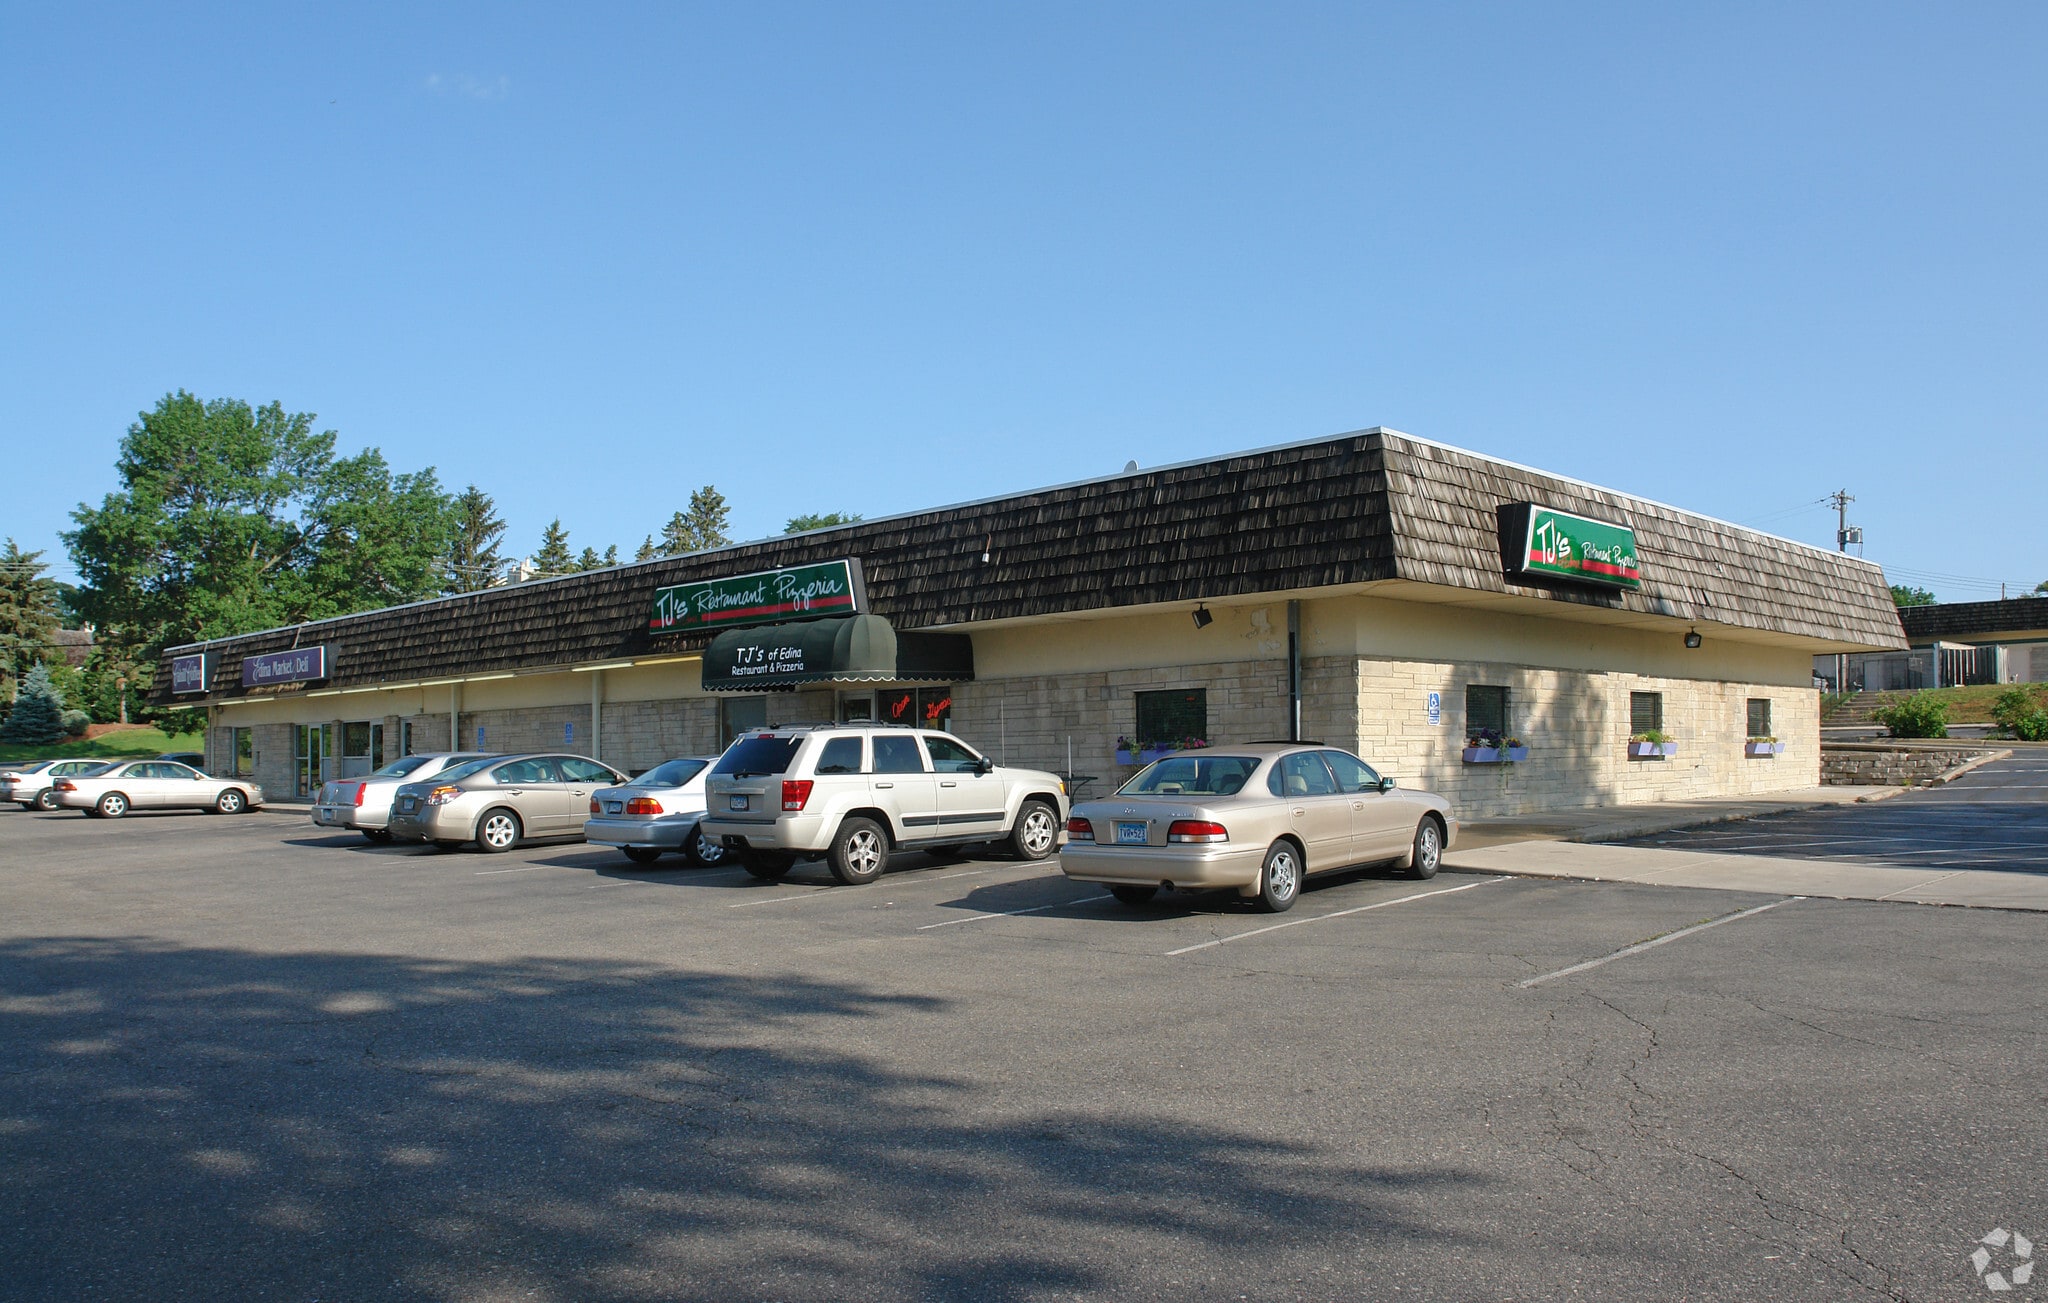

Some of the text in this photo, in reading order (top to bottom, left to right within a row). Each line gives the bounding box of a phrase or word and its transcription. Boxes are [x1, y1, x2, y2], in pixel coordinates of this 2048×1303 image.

[1537, 518, 1571, 565] TJ's
[656, 574, 844, 628] TJ's Restaurant Pizzeria
[736, 645, 802, 664] TJ's of Edina
[272, 661, 294, 678] Market
[296, 656, 309, 674] Deli
[731, 661, 804, 676] Restaurant & Pizzeria
